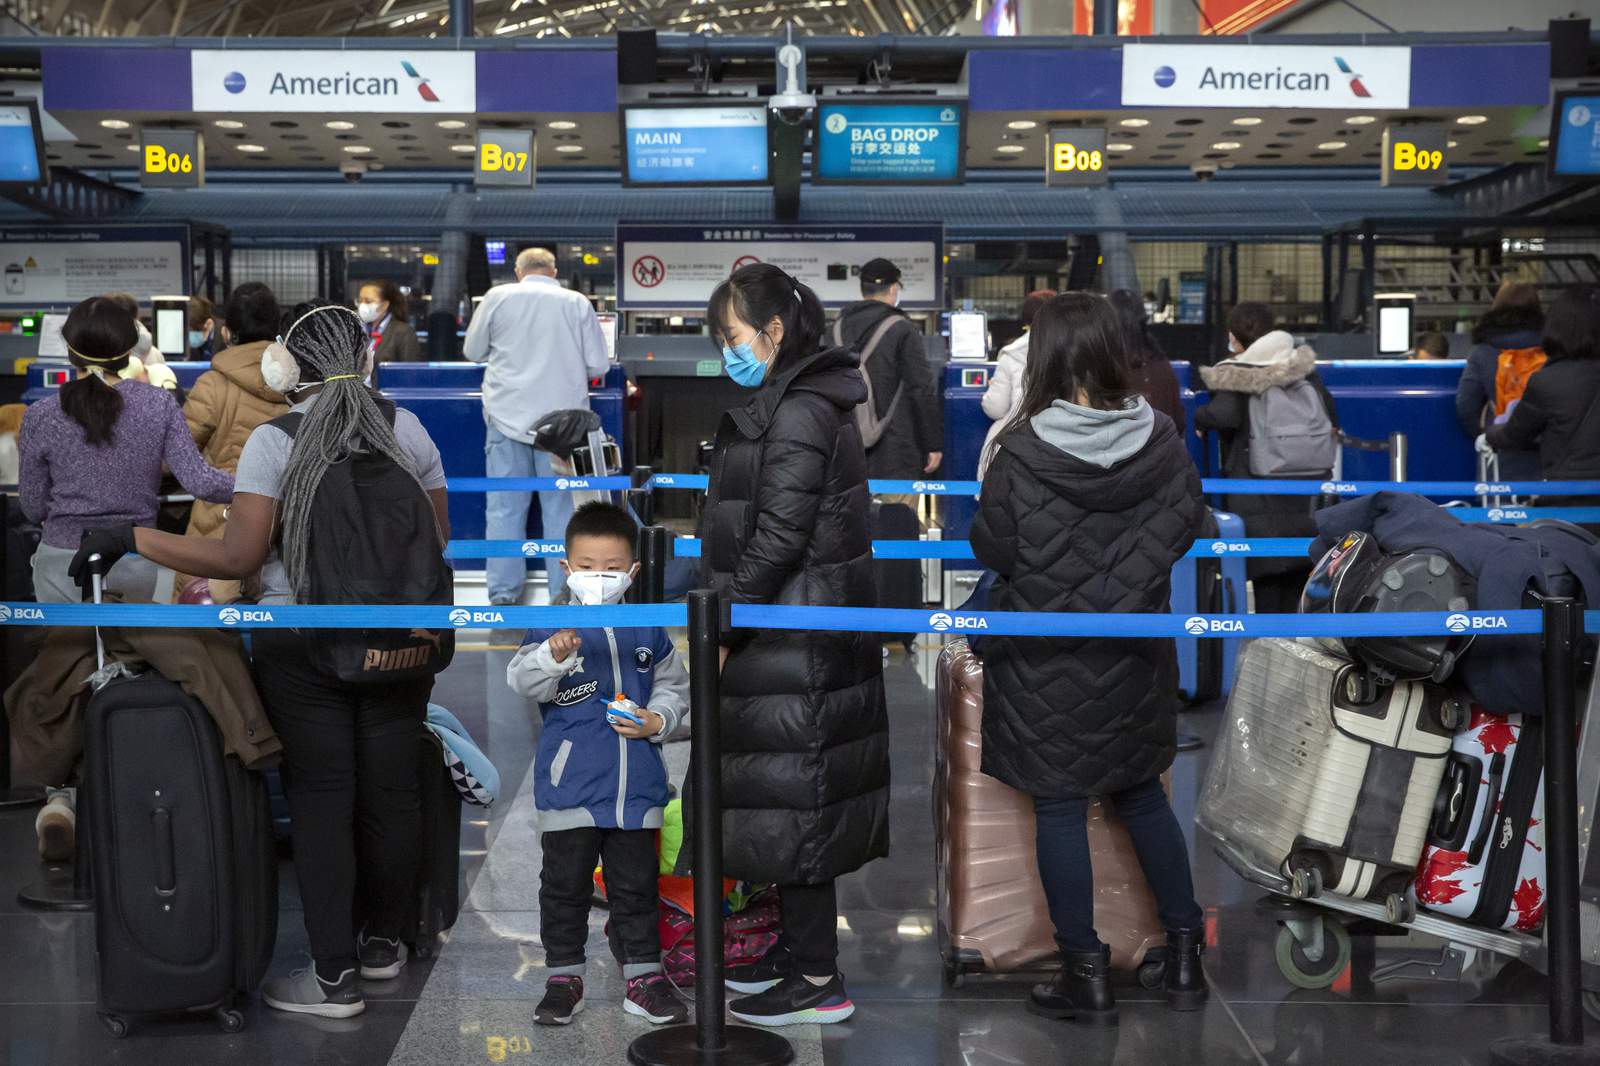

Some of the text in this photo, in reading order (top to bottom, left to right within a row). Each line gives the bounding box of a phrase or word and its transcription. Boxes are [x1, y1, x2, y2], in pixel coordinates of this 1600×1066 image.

[269, 71, 399, 96] American
[1198, 66, 1330, 91] American
[635, 132, 682, 145] MAIN
[851, 128, 939, 142] BAG DROP
[145, 144, 193, 173] B06
[480, 143, 528, 172] B07
[1053, 143, 1103, 172] B08
[1393, 142, 1443, 171] B09
[569, 480, 589, 488] BCIA
[927, 483, 946, 491] BCIA
[1336, 484, 1357, 492] BCIA
[1505, 511, 1528, 519] BCIA
[541, 544, 566, 553] BCIA
[14, 608, 44, 620] BCIA
[243, 611, 273, 623] BCIA
[473, 611, 504, 623] BCIA
[954, 616, 988, 629] BCIA
[1210, 619, 1245, 632] BCIA
[1472, 616, 1508, 630] BCIA
[363, 644, 431, 672] PUMA
